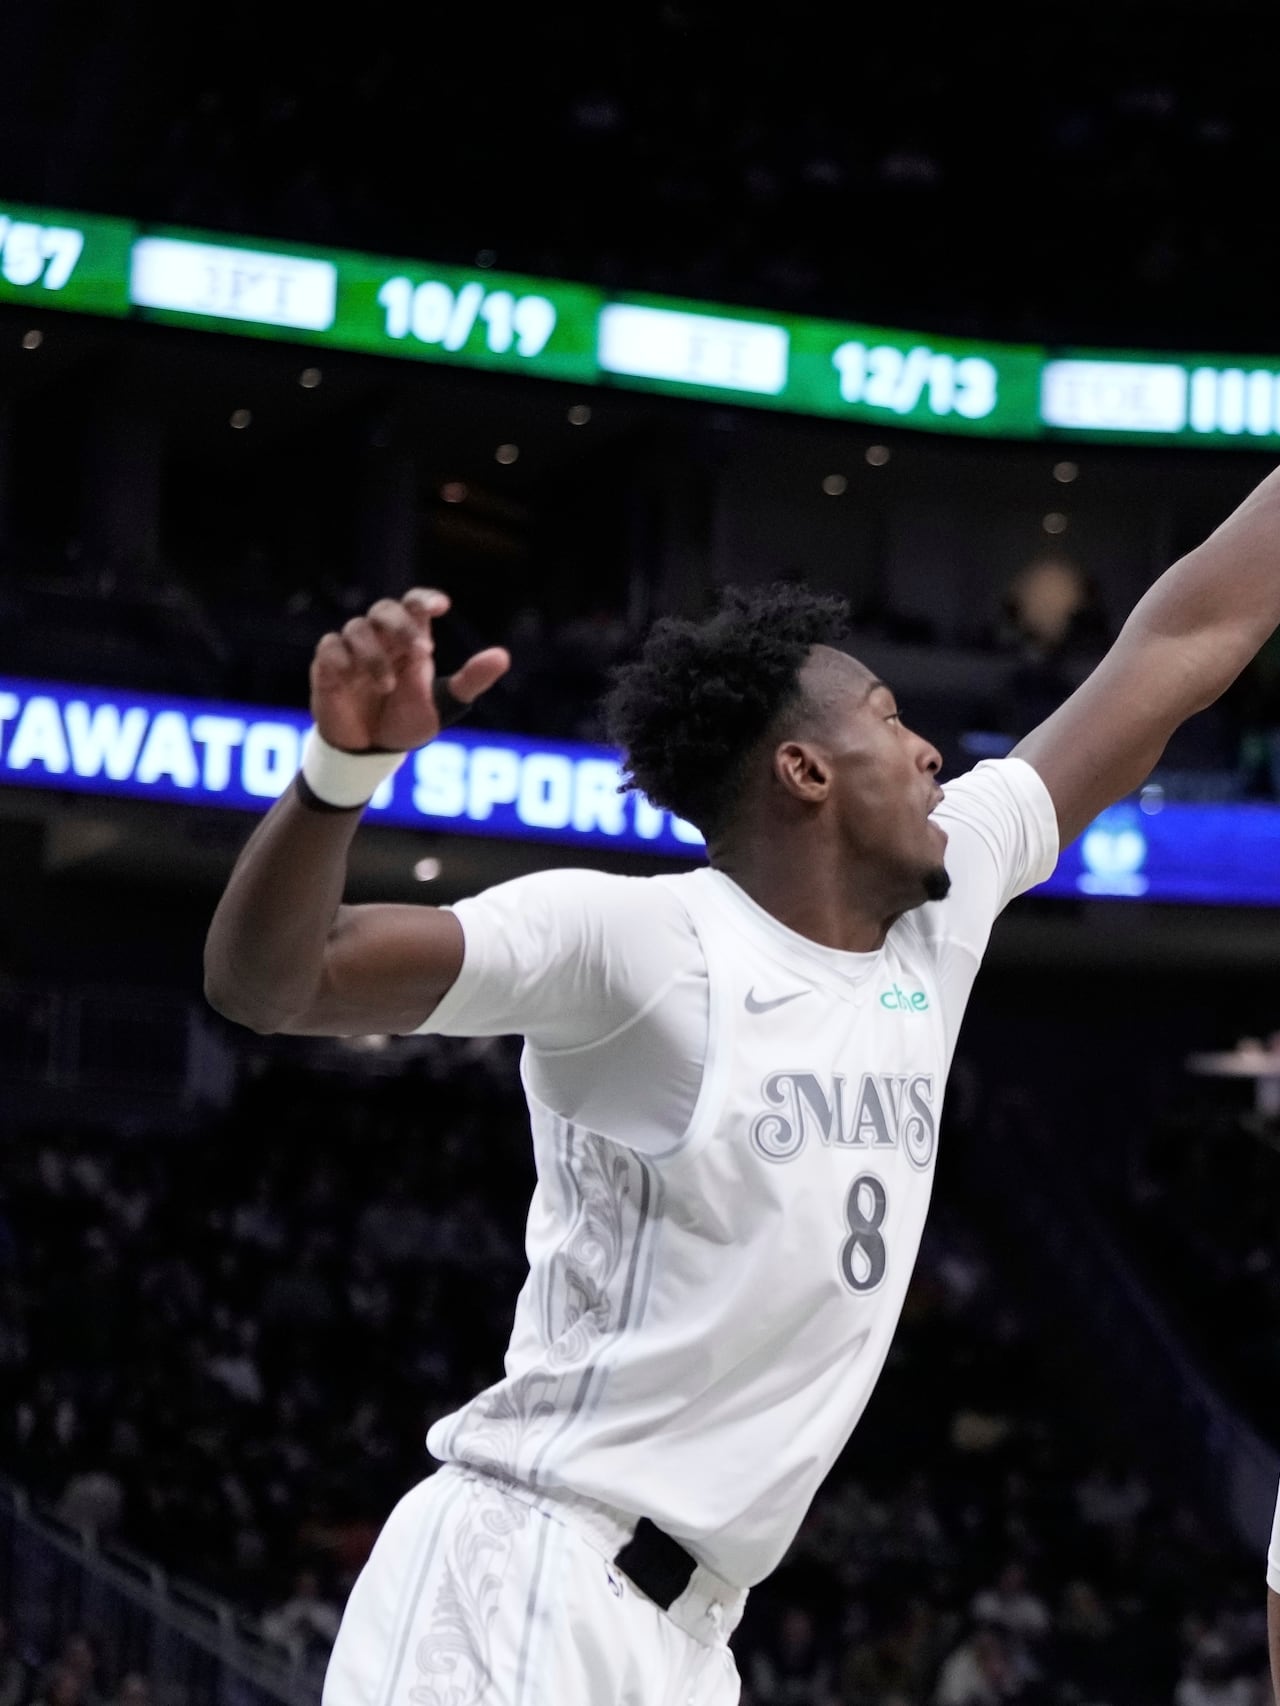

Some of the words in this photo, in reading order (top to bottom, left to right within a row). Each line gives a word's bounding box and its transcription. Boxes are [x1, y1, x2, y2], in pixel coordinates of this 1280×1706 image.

[378, 276, 557, 358] 10/19
[832, 341, 998, 420] 12/13
[750, 1070, 937, 1171] MAVS
[839, 1172, 888, 1295] 8
